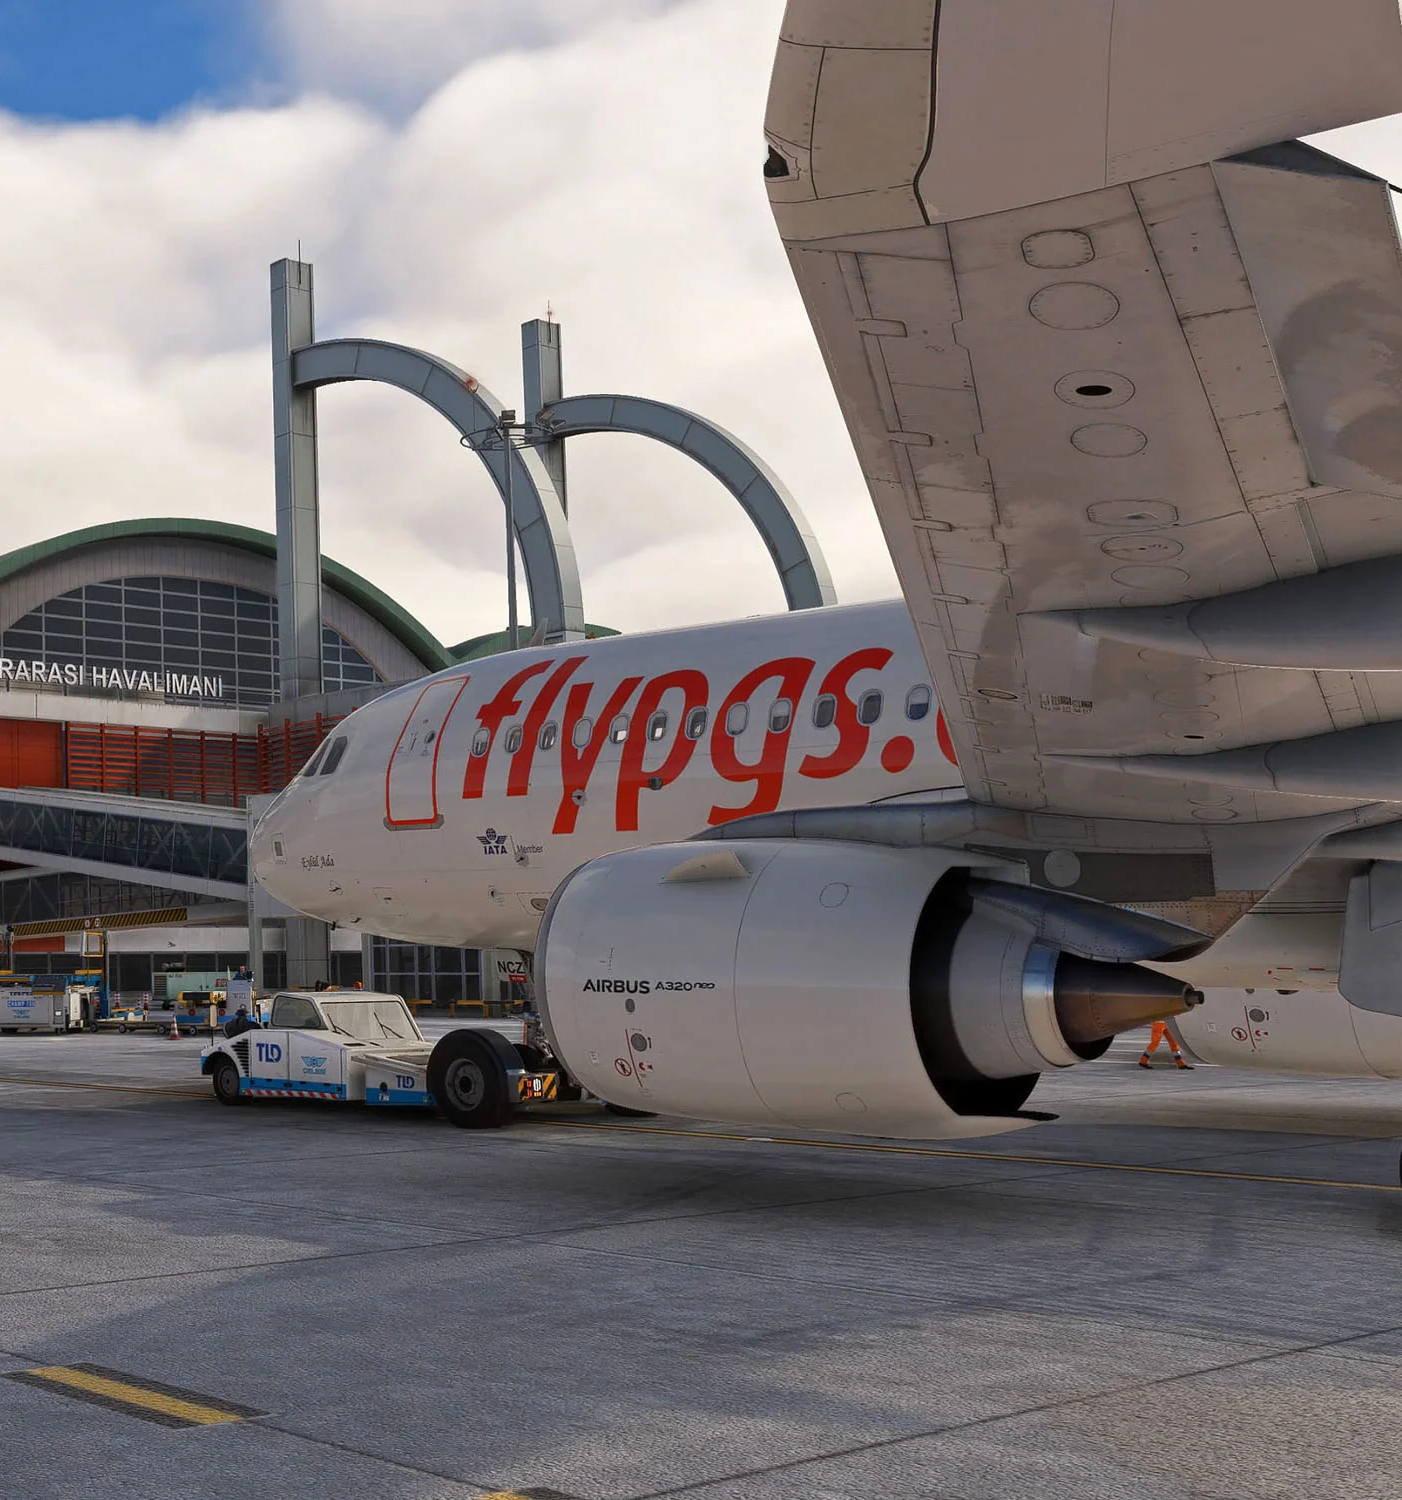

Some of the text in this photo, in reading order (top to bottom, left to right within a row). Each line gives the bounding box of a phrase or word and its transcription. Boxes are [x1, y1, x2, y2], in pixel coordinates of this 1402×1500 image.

[462, 648, 959, 834] flypgs.
[484, 845, 508, 855] IATA
[516, 844, 543, 854] Member
[497, 960, 527, 974] NCZ
[583, 978, 651, 994] AIRBUS
[256, 1042, 283, 1063] TLD
[396, 1075, 415, 1089] TLD
